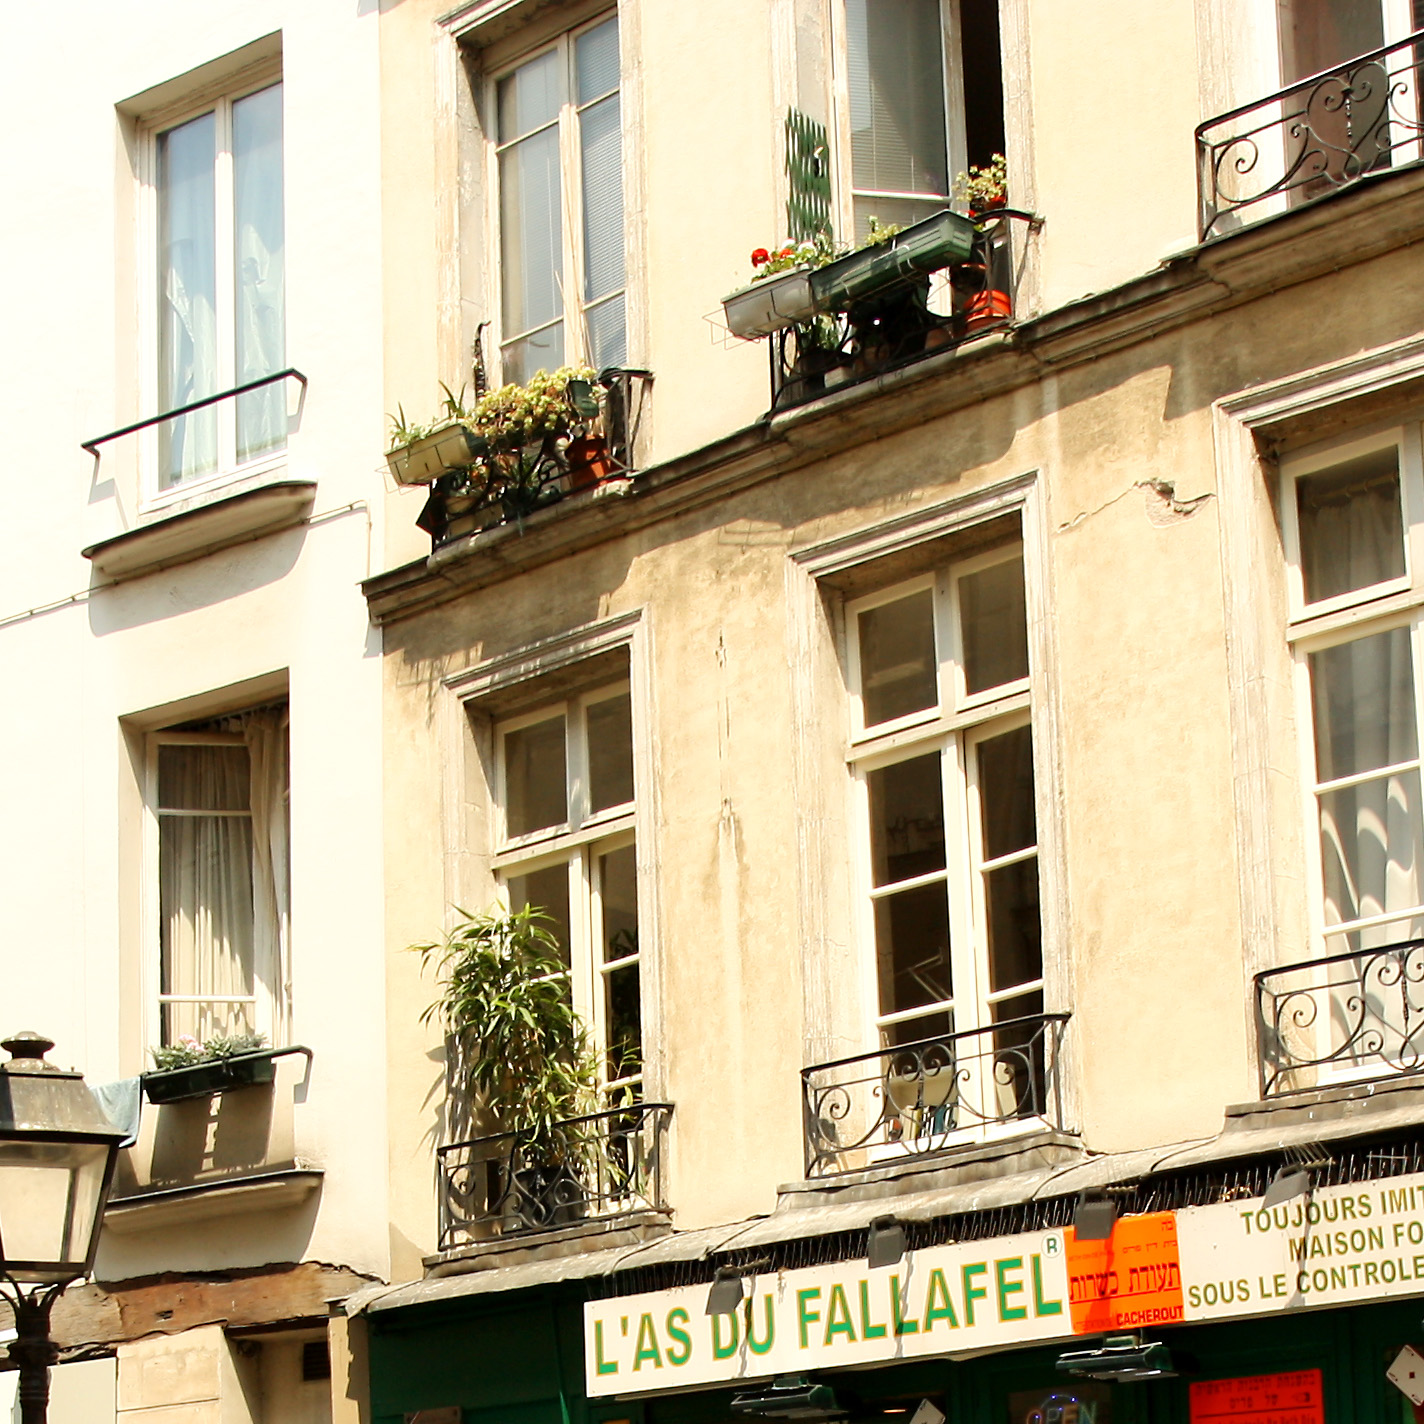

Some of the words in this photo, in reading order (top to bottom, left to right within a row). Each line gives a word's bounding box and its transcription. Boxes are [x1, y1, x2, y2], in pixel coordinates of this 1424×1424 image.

[1242, 1195, 1373, 1236] TOUJOURS
[1289, 1229, 1384, 1263] MAISON
[1188, 1282, 1252, 1309] SOUS
[1258, 1273, 1288, 1300] LE
[594, 1306, 693, 1377] L'AS
[712, 1294, 776, 1361] DU
[798, 1253, 1063, 1350] FALLAFEL
[1116, 1305, 1183, 1326] CACHEROUT
